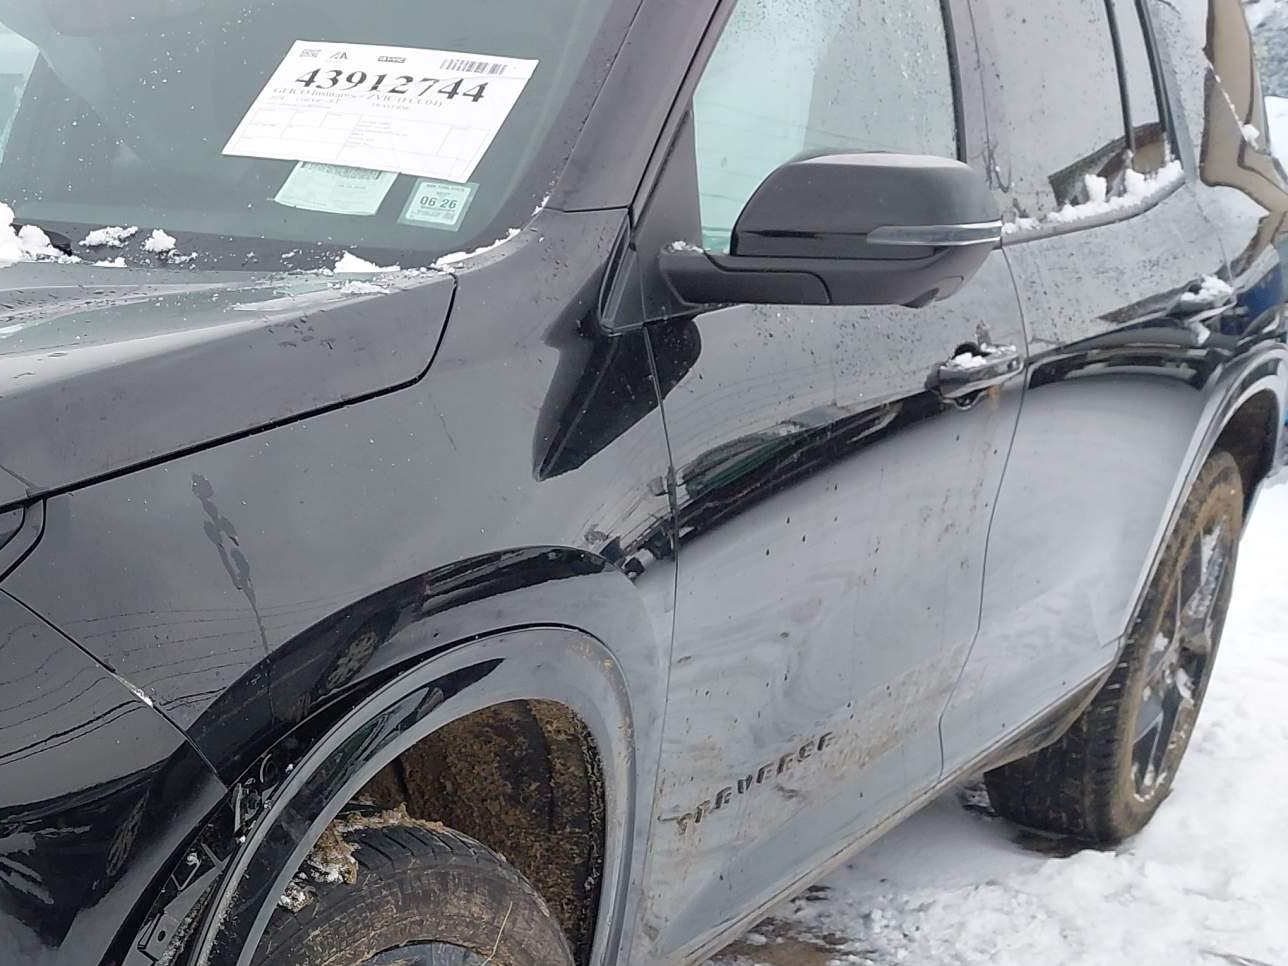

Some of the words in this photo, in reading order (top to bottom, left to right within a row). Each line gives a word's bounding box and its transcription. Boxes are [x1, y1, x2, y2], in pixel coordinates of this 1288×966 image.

[296, 68, 489, 102] 43912744
[419, 195, 437, 207] 06
[439, 198, 458, 209] 26
